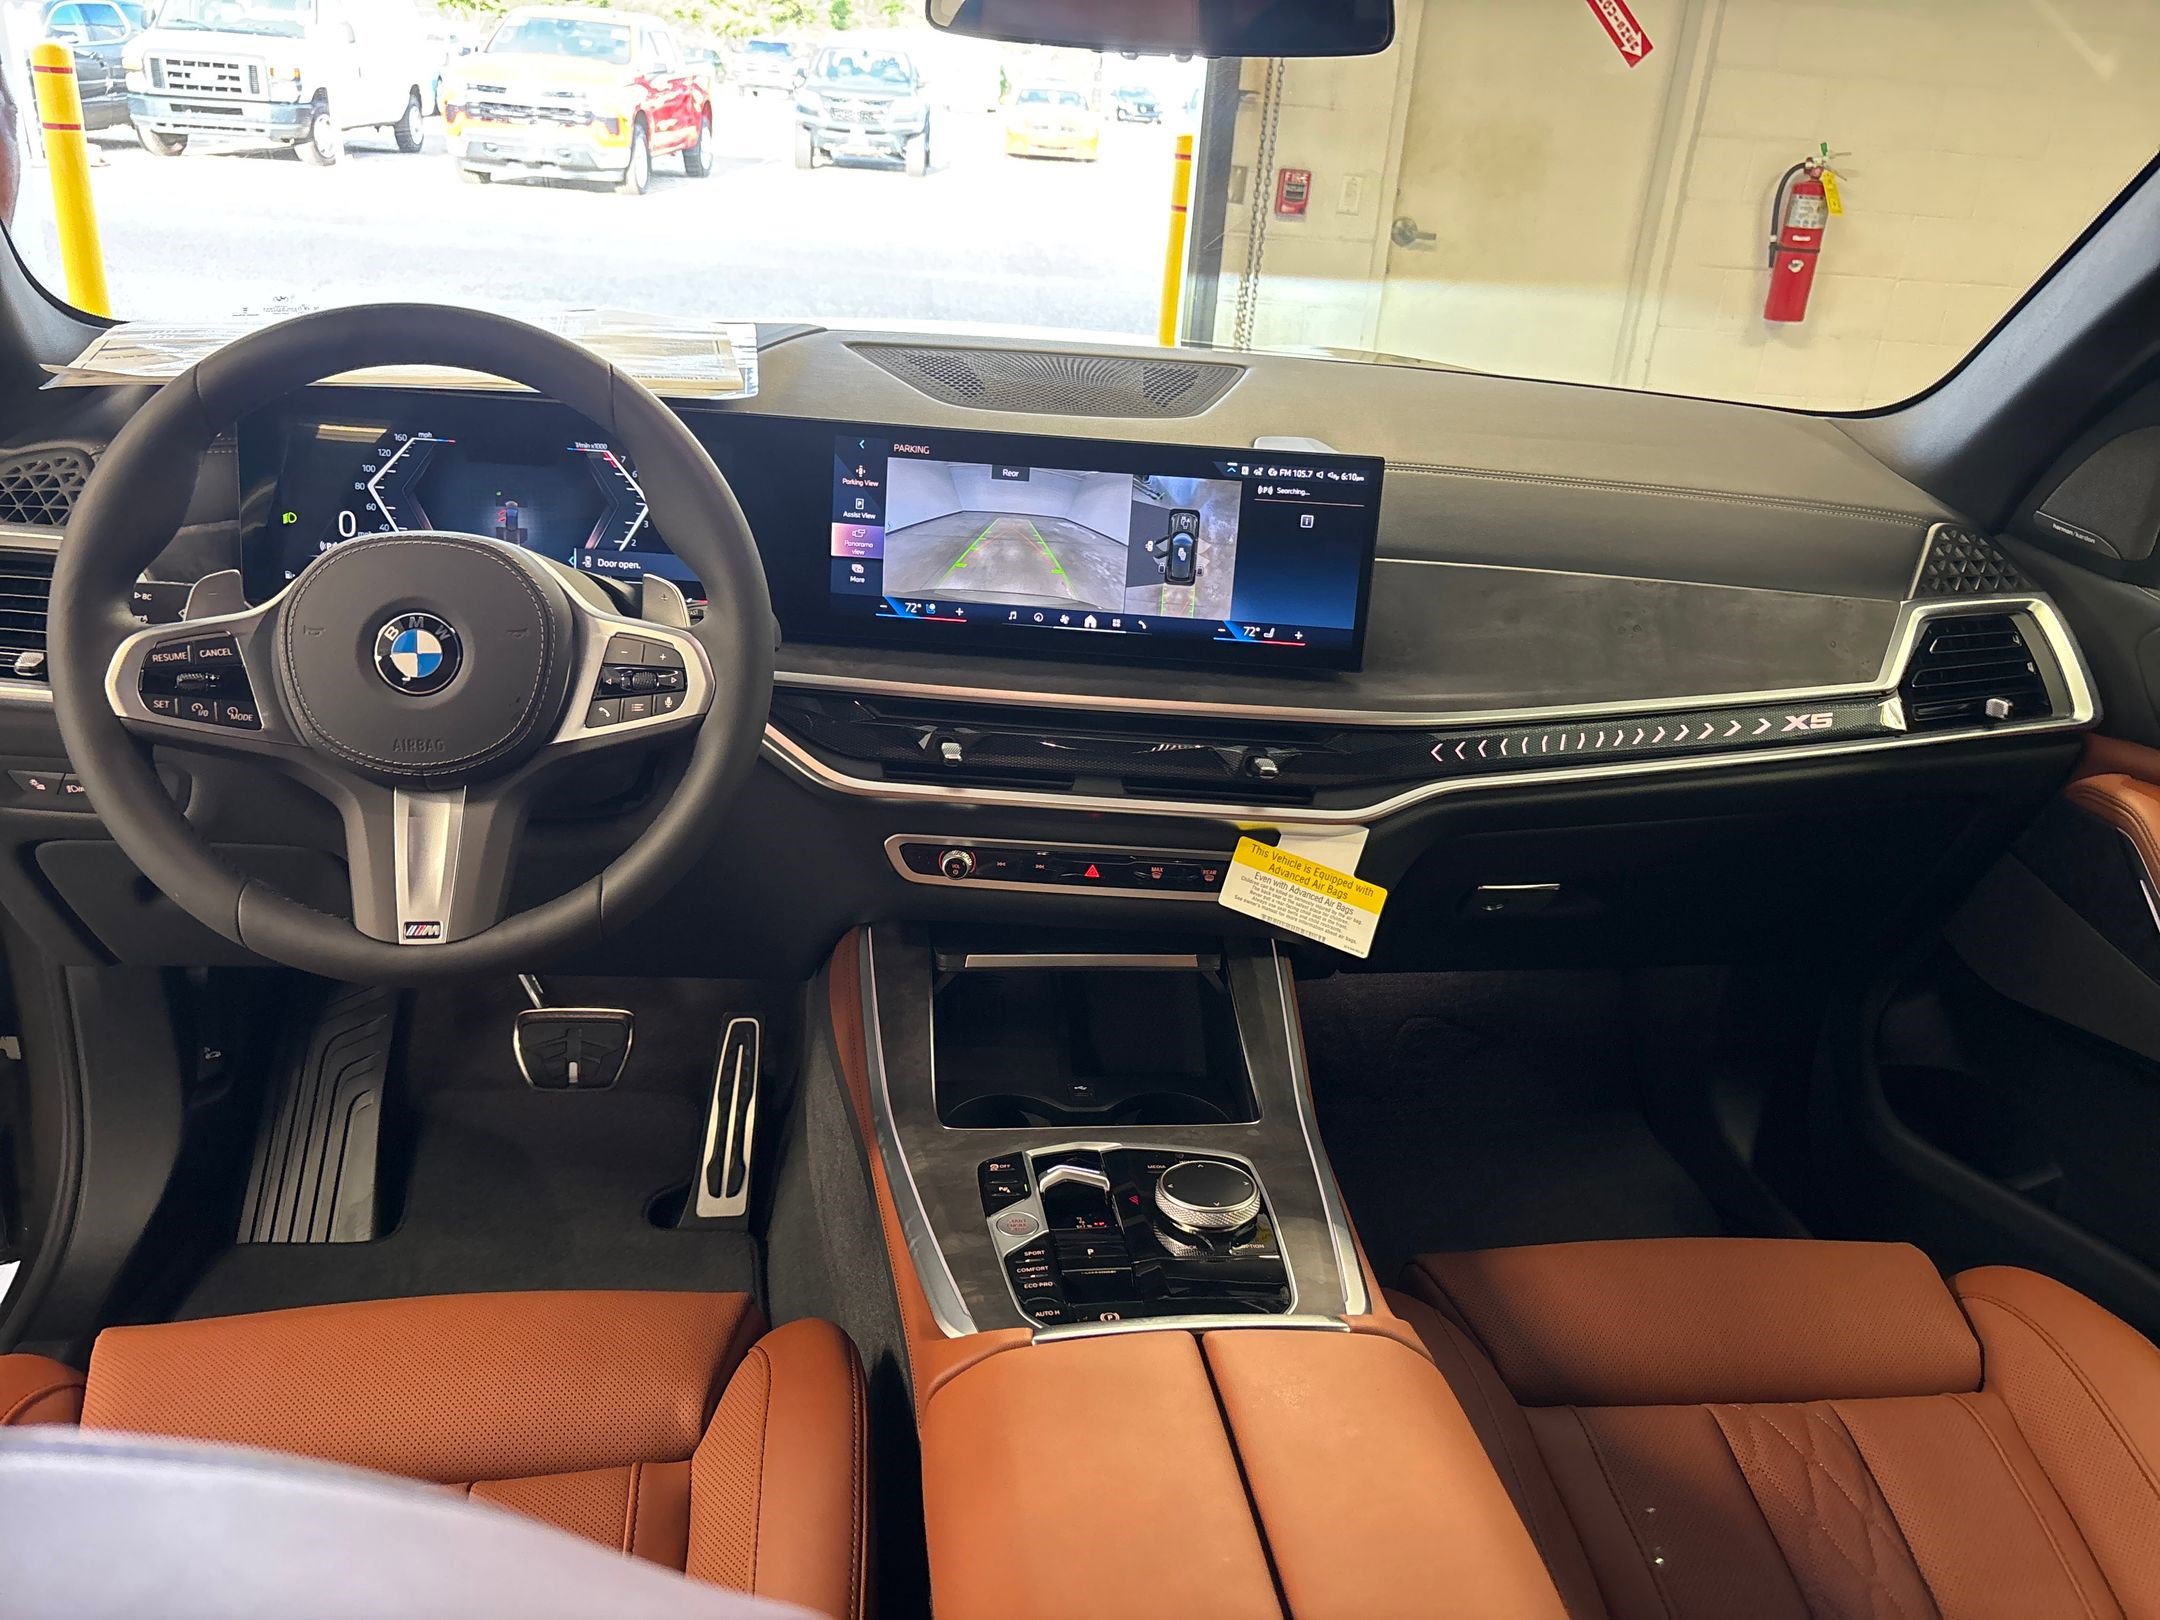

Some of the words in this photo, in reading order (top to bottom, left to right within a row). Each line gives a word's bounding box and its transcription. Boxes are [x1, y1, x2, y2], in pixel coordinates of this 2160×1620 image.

[1599, 0, 1639, 51] GUISHER
[1285, 171, 1308, 183] FIRE
[394, 434, 408, 442] 160
[894, 444, 930, 454] PARKING
[1002, 469, 1019, 477] Rear
[1293, 470, 1313, 478] 105.7
[842, 478, 863, 487] Parking
[338, 510, 356, 537] 0
[844, 540, 873, 548] Panorama
[598, 558, 617, 568] Door
[619, 560, 641, 569] open.
[905, 602, 921, 613] 72°
[384, 616, 450, 642] BMW
[1243, 626, 1260, 637] 72°
[152, 652, 187, 662] RESUME
[200, 648, 232, 658] CANCEL
[153, 700, 170, 708] SET
[1781, 712, 1833, 731] X5
[392, 738, 445, 753] AIRBAG
[1250, 844, 1269, 857] This
[1271, 851, 1302, 869] Vehicle
[1303, 864, 1312, 873] is
[1312, 867, 1353, 890] Equipped
[1354, 883, 1374, 896] with
[1268, 863, 1310, 885] Advanced
[1311, 879, 1324, 890] Air
[1325, 884, 1348, 901] Bags
[1240, 876, 1259, 885] Children
[1294, 896, 1314, 905] seriously
[1315, 903, 1330, 912] injured
[1254, 872, 1272, 884] Even
[1272, 878, 1288, 889] with
[1288, 884, 1324, 903] Advanced
[1324, 898, 1335, 907] Air
[1335, 902, 1354, 916] Bags
[1251, 896, 1267, 905] Always
[1243, 898, 1260, 907] owner's
[1297, 918, 1324, 931] information
